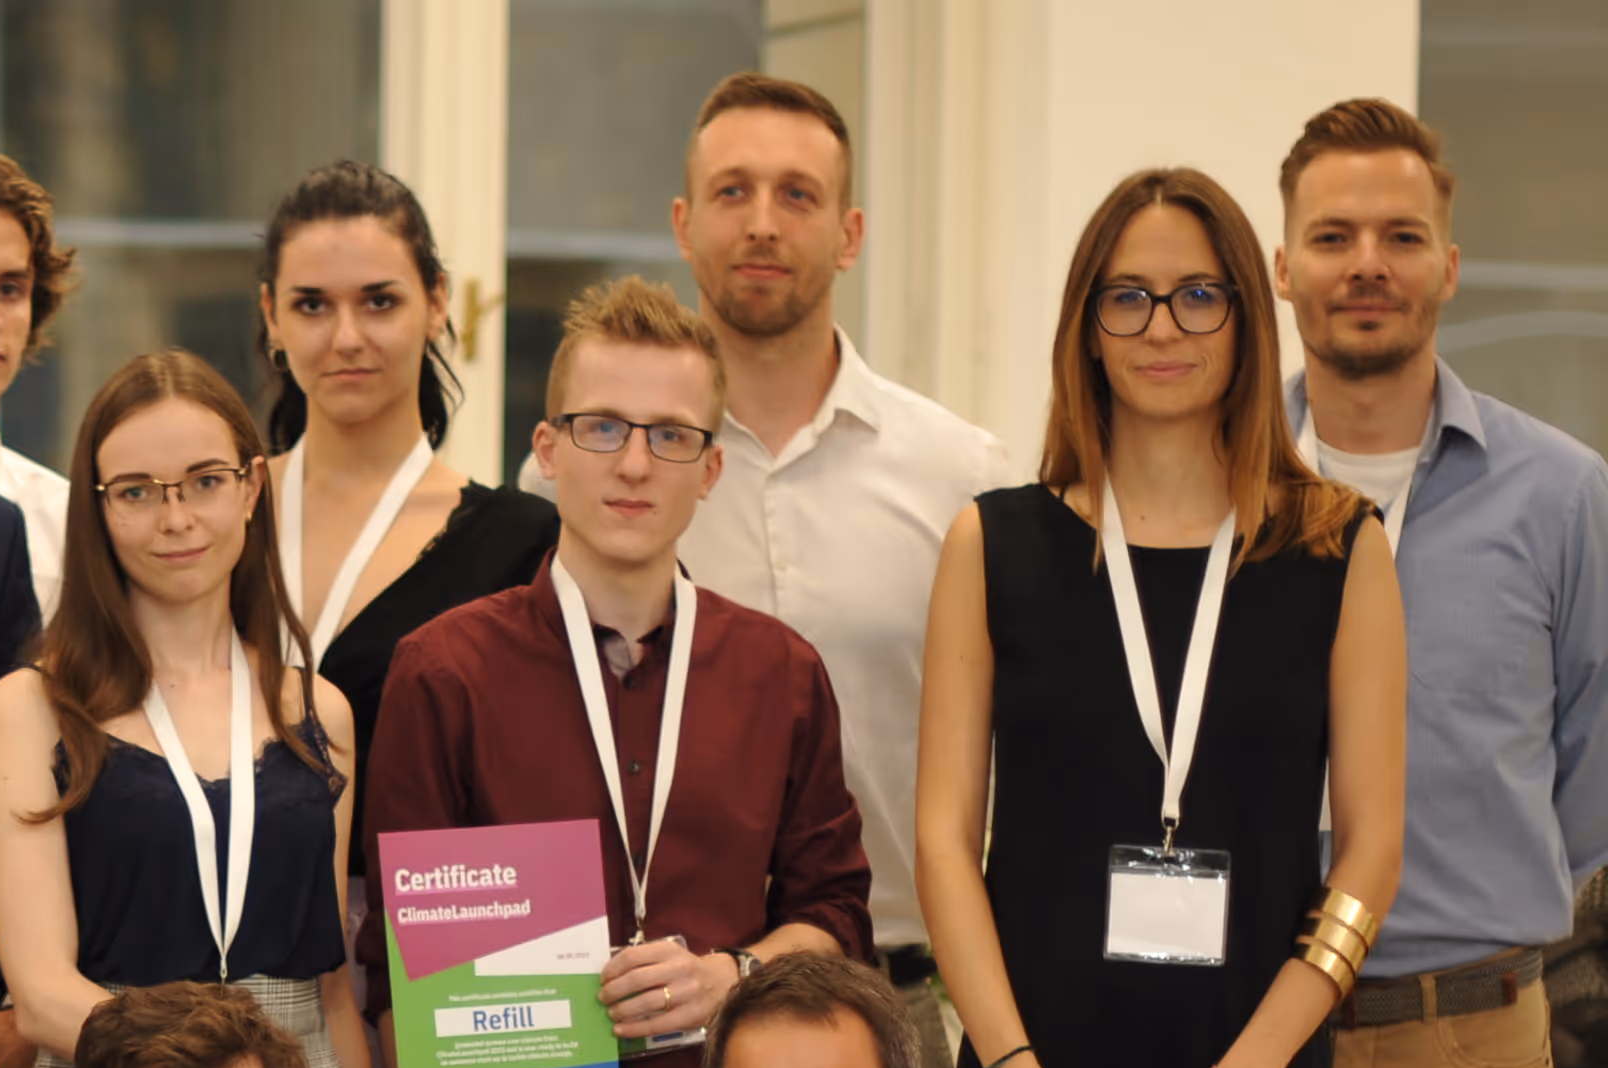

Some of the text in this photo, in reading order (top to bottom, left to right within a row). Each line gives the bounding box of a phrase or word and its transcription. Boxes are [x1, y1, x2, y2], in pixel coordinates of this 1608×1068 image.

[395, 863, 518, 892] Certificate
[397, 899, 531, 925] ClimateLaunchpad
[473, 1006, 534, 1032] Refill
